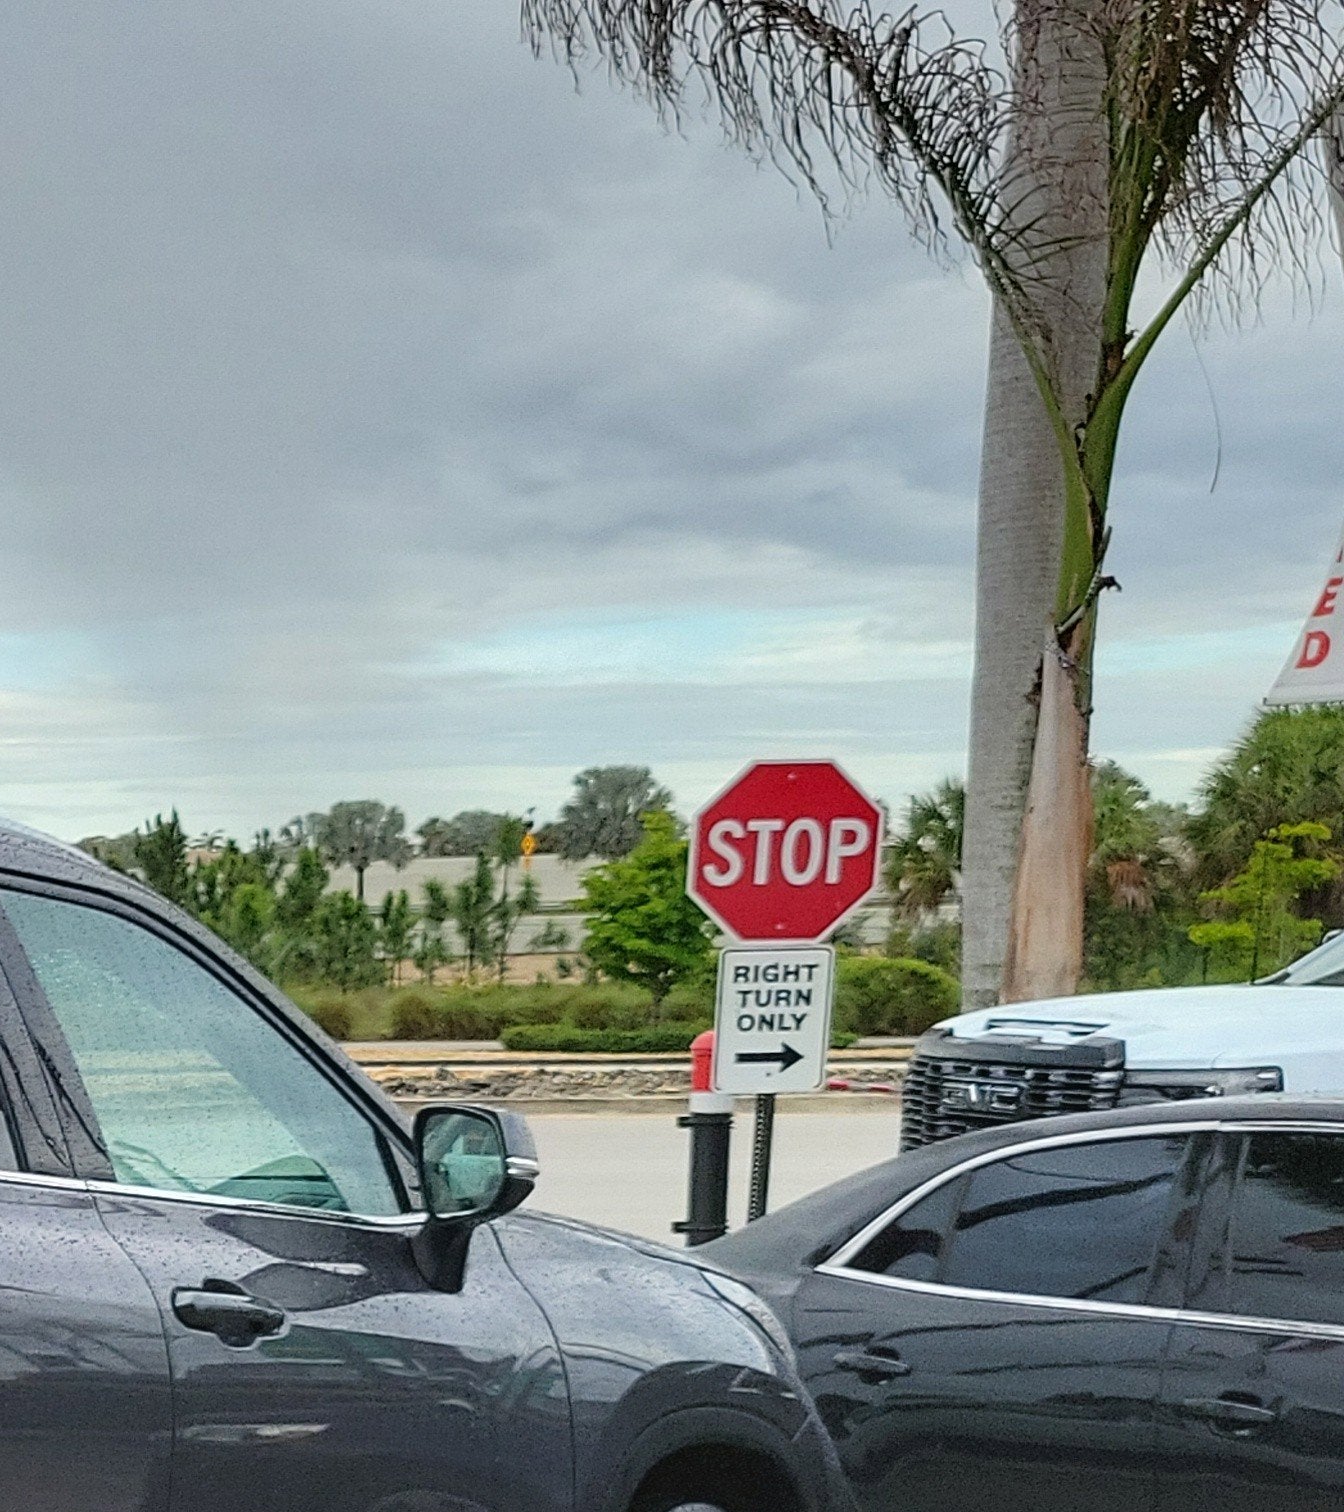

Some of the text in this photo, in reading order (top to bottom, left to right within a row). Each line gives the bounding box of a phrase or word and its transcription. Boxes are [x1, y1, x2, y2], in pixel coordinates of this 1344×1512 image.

[702, 818, 870, 886] STOP
[733, 964, 819, 983] RIGHT
[737, 989, 812, 1008] TURN
[736, 1014, 808, 1032] ONLY
